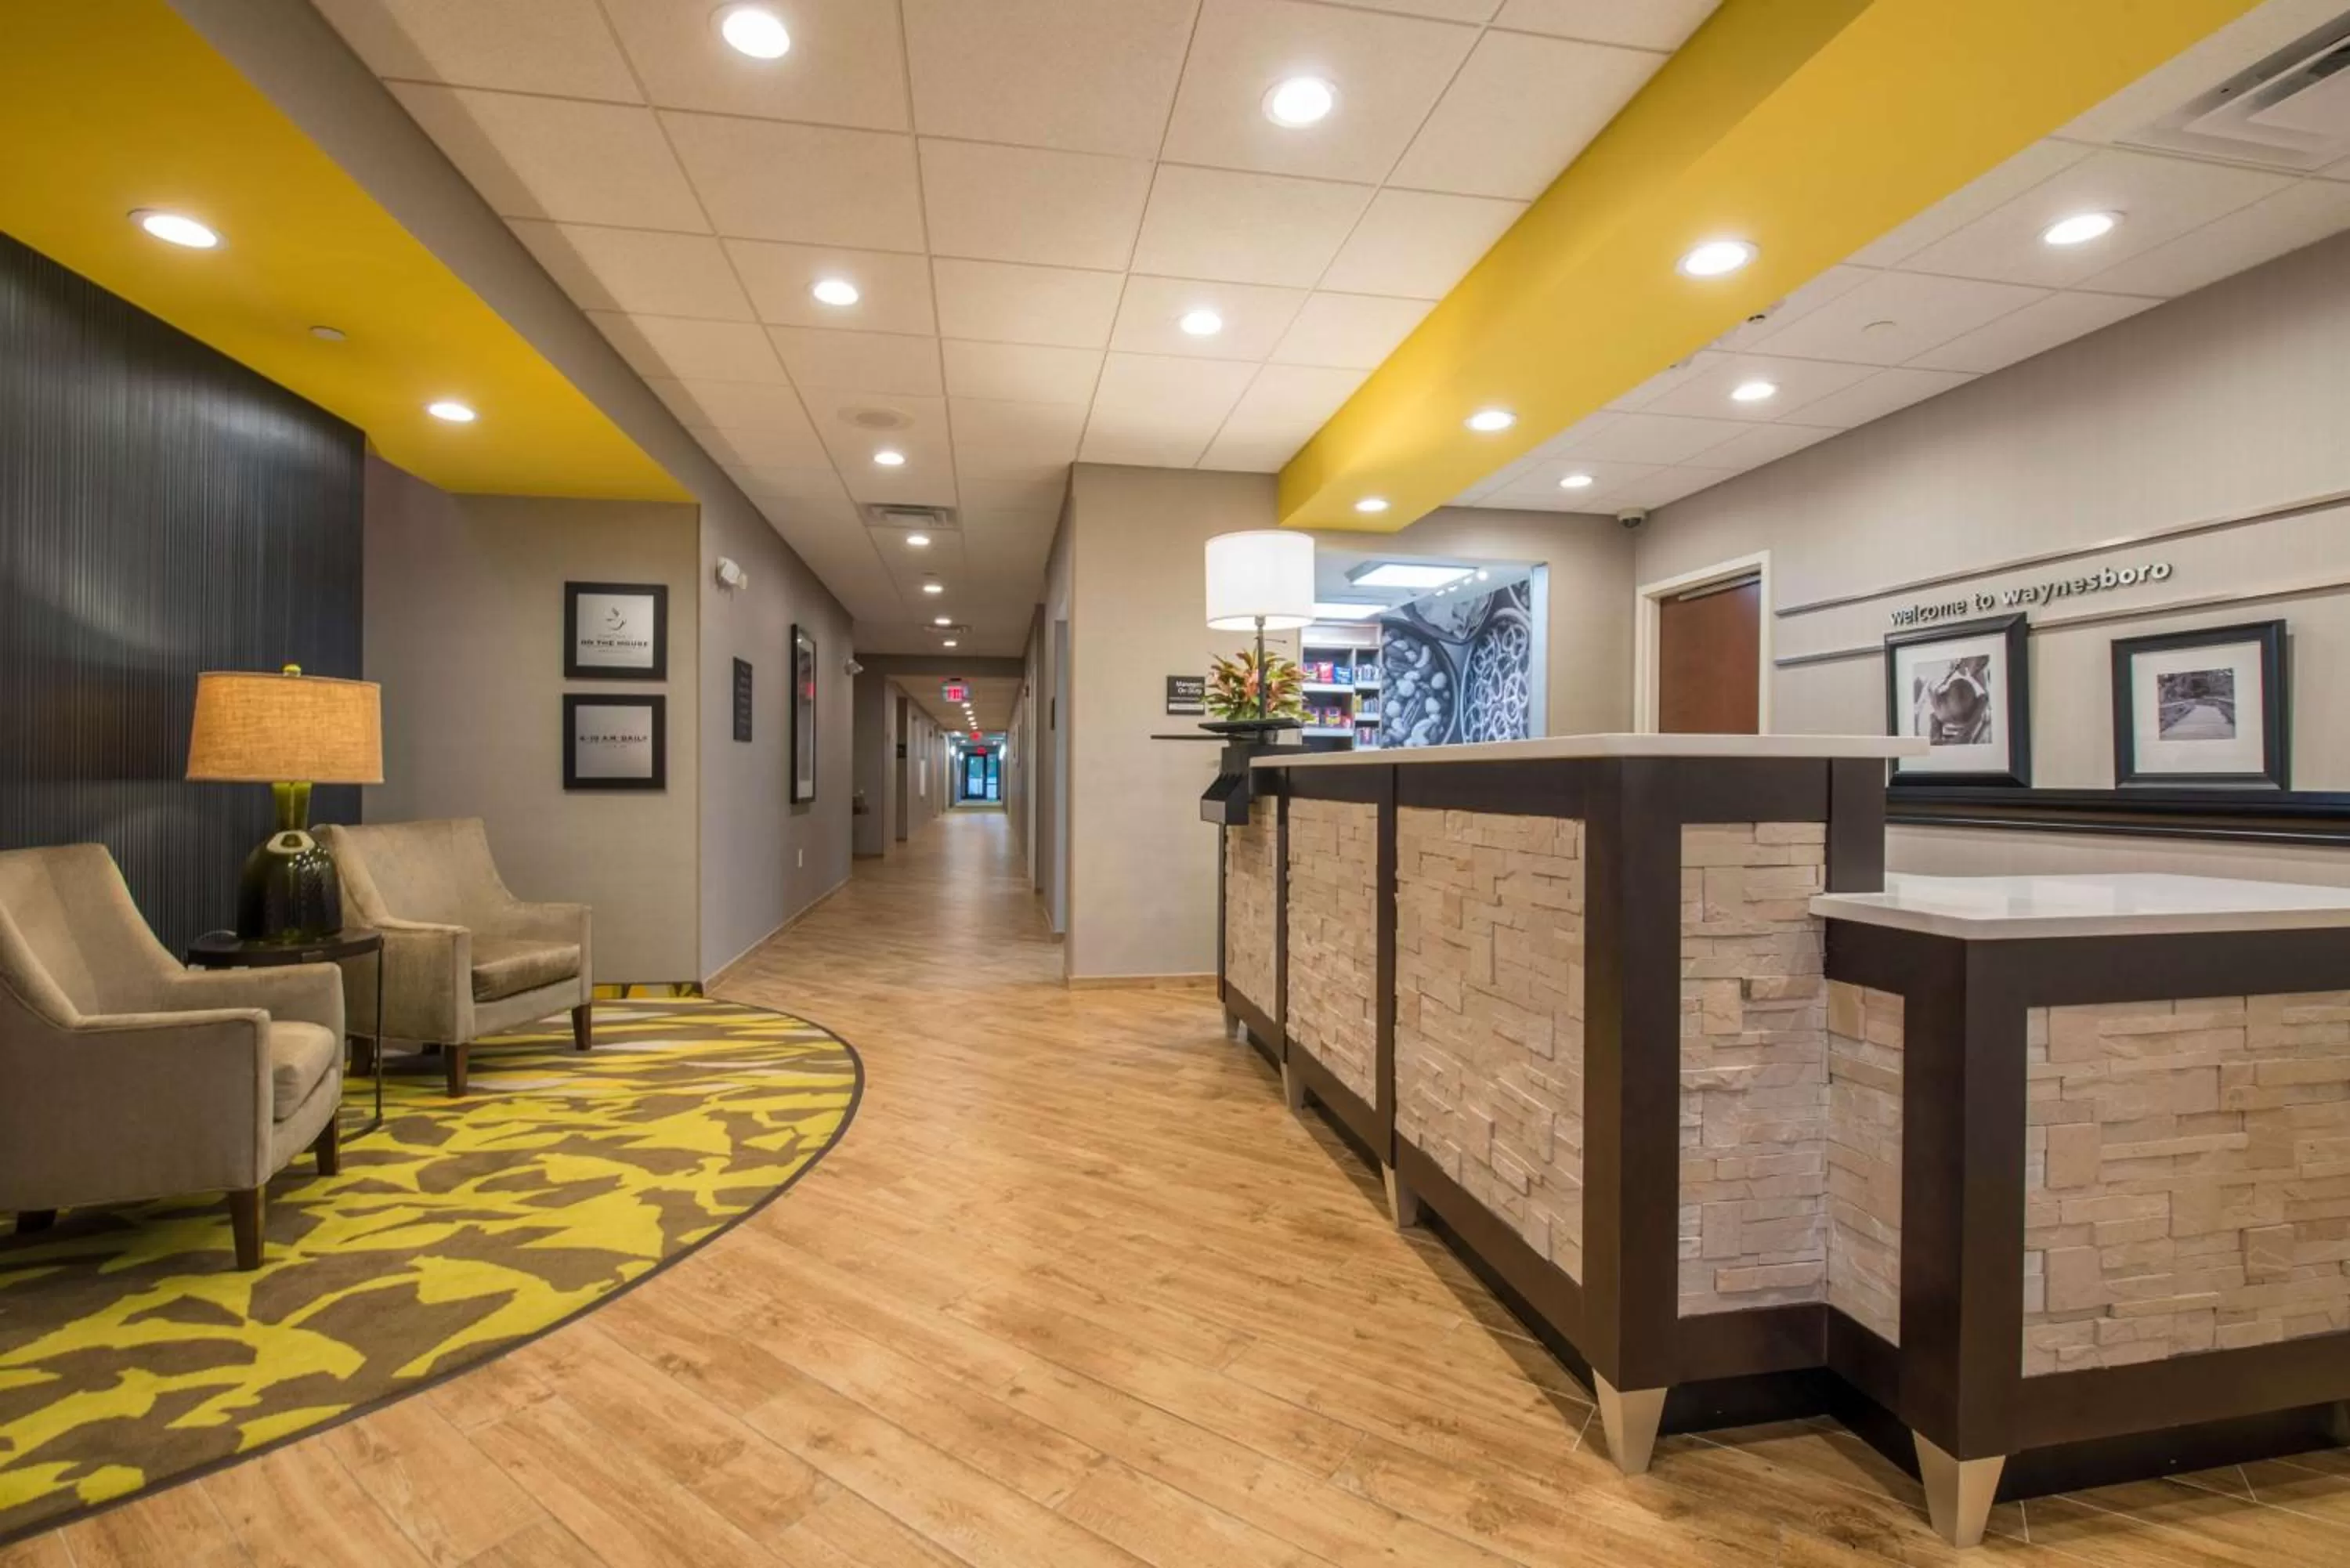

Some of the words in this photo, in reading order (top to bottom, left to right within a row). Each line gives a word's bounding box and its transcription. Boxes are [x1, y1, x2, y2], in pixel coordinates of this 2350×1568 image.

[1889, 601, 1968, 626] welcome
[1974, 593, 1996, 612] to
[2001, 562, 2172, 607] waynesboro
